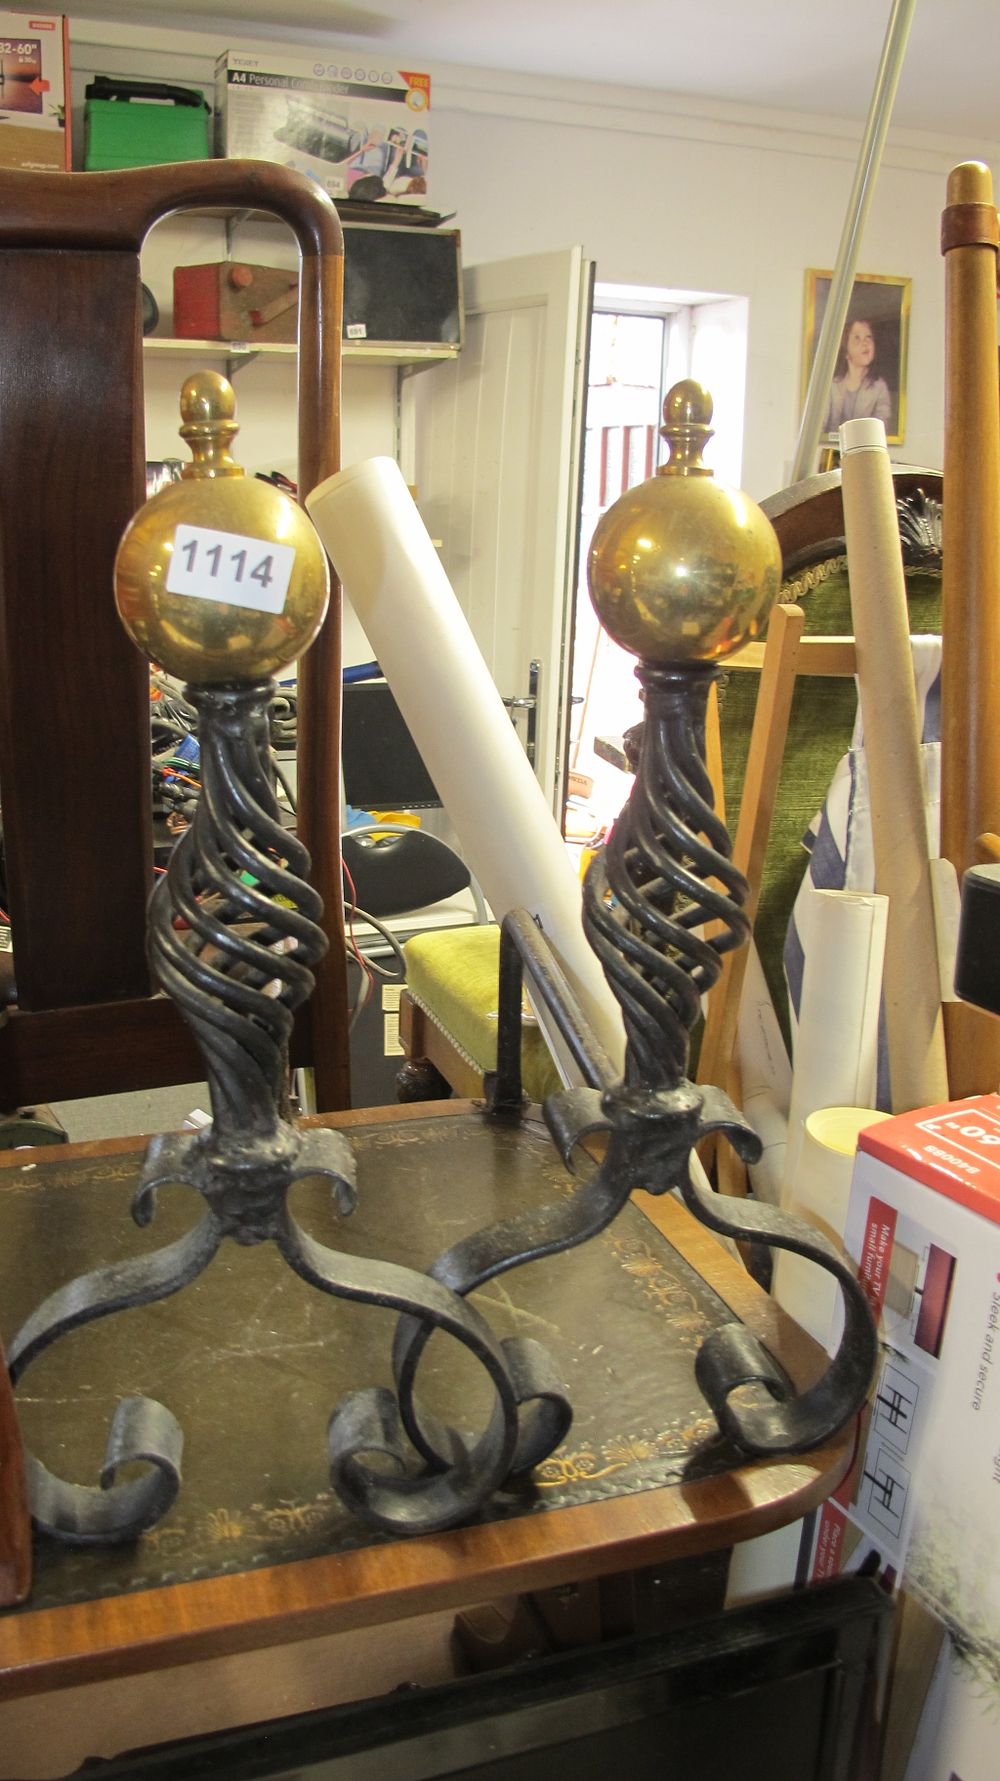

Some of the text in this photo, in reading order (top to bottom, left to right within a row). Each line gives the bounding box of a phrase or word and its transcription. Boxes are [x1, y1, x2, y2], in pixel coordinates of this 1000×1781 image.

[232, 72, 247, 83] A4
[249, 73, 289, 89] Personal
[409, 76, 429, 88] FREE
[182, 539, 274, 588] 1114
[867, 1222, 878, 1252] small
[872, 1223, 891, 1296] Make your TV
[981, 1333, 995, 1365] and
[971, 1364, 989, 1412] secure
